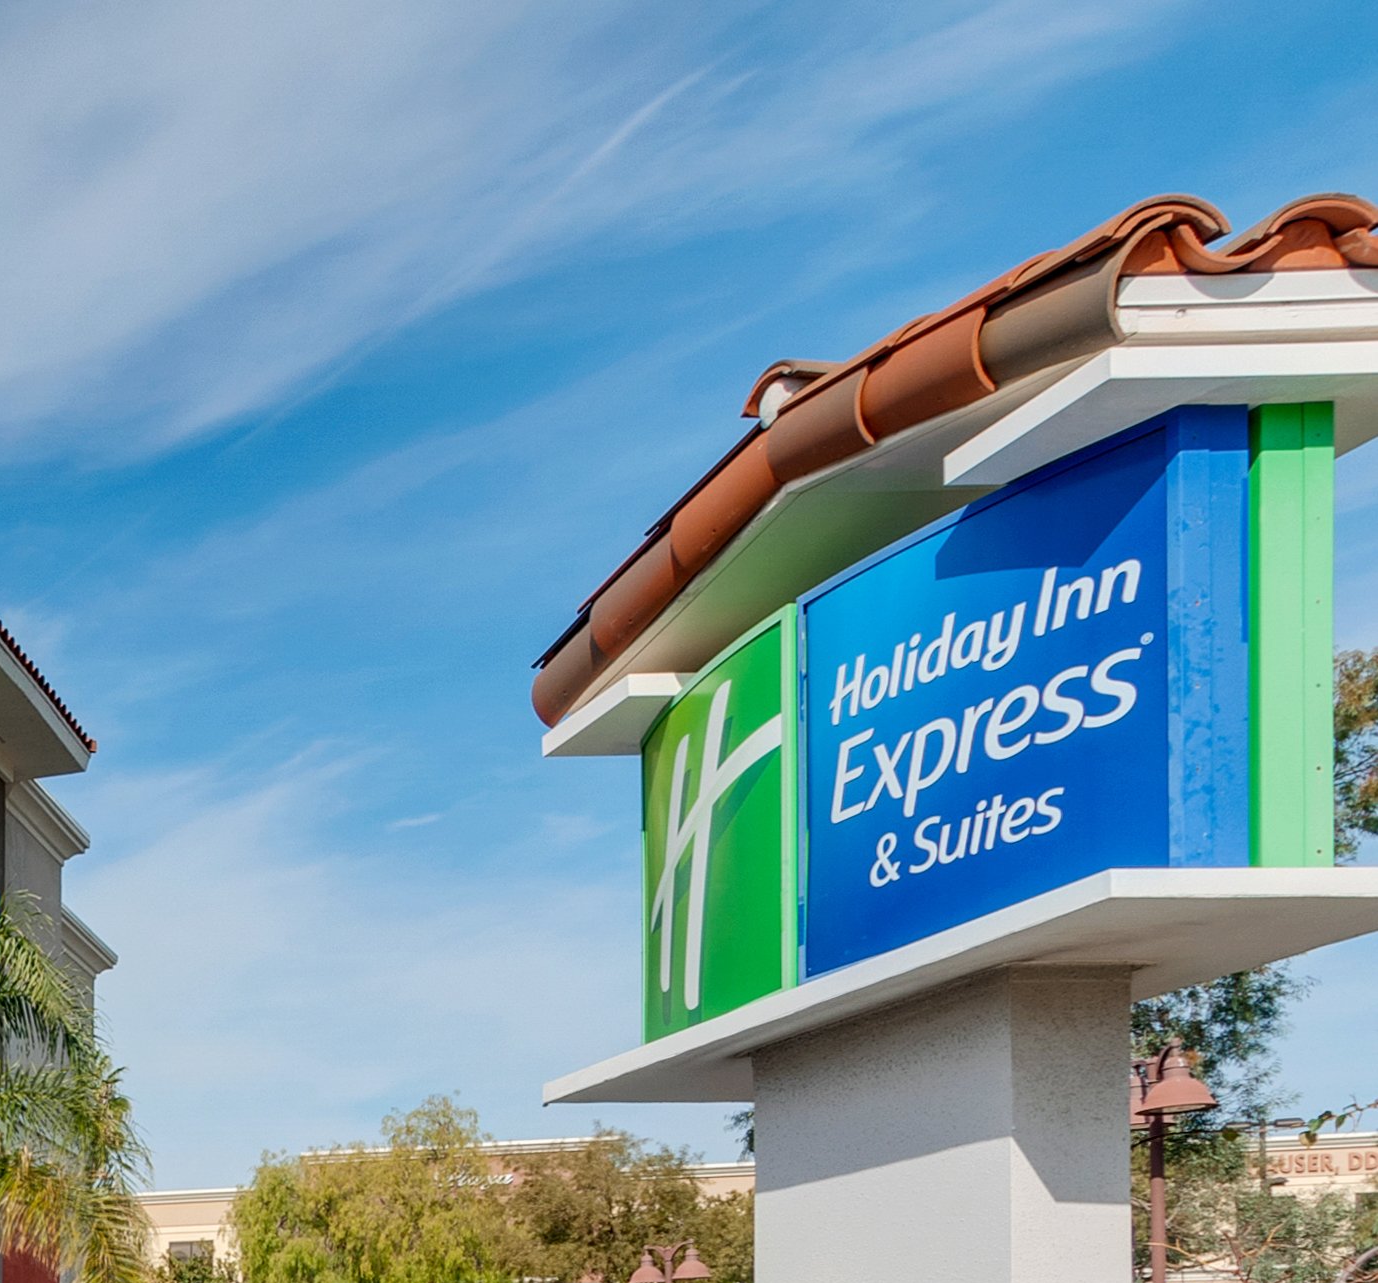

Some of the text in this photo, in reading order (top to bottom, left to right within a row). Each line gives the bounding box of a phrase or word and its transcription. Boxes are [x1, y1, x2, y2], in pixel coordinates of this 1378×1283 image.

[828, 557, 1142, 727] Holiday Inn
[829, 646, 1142, 825] Express
[868, 786, 1065, 889] & Suites
